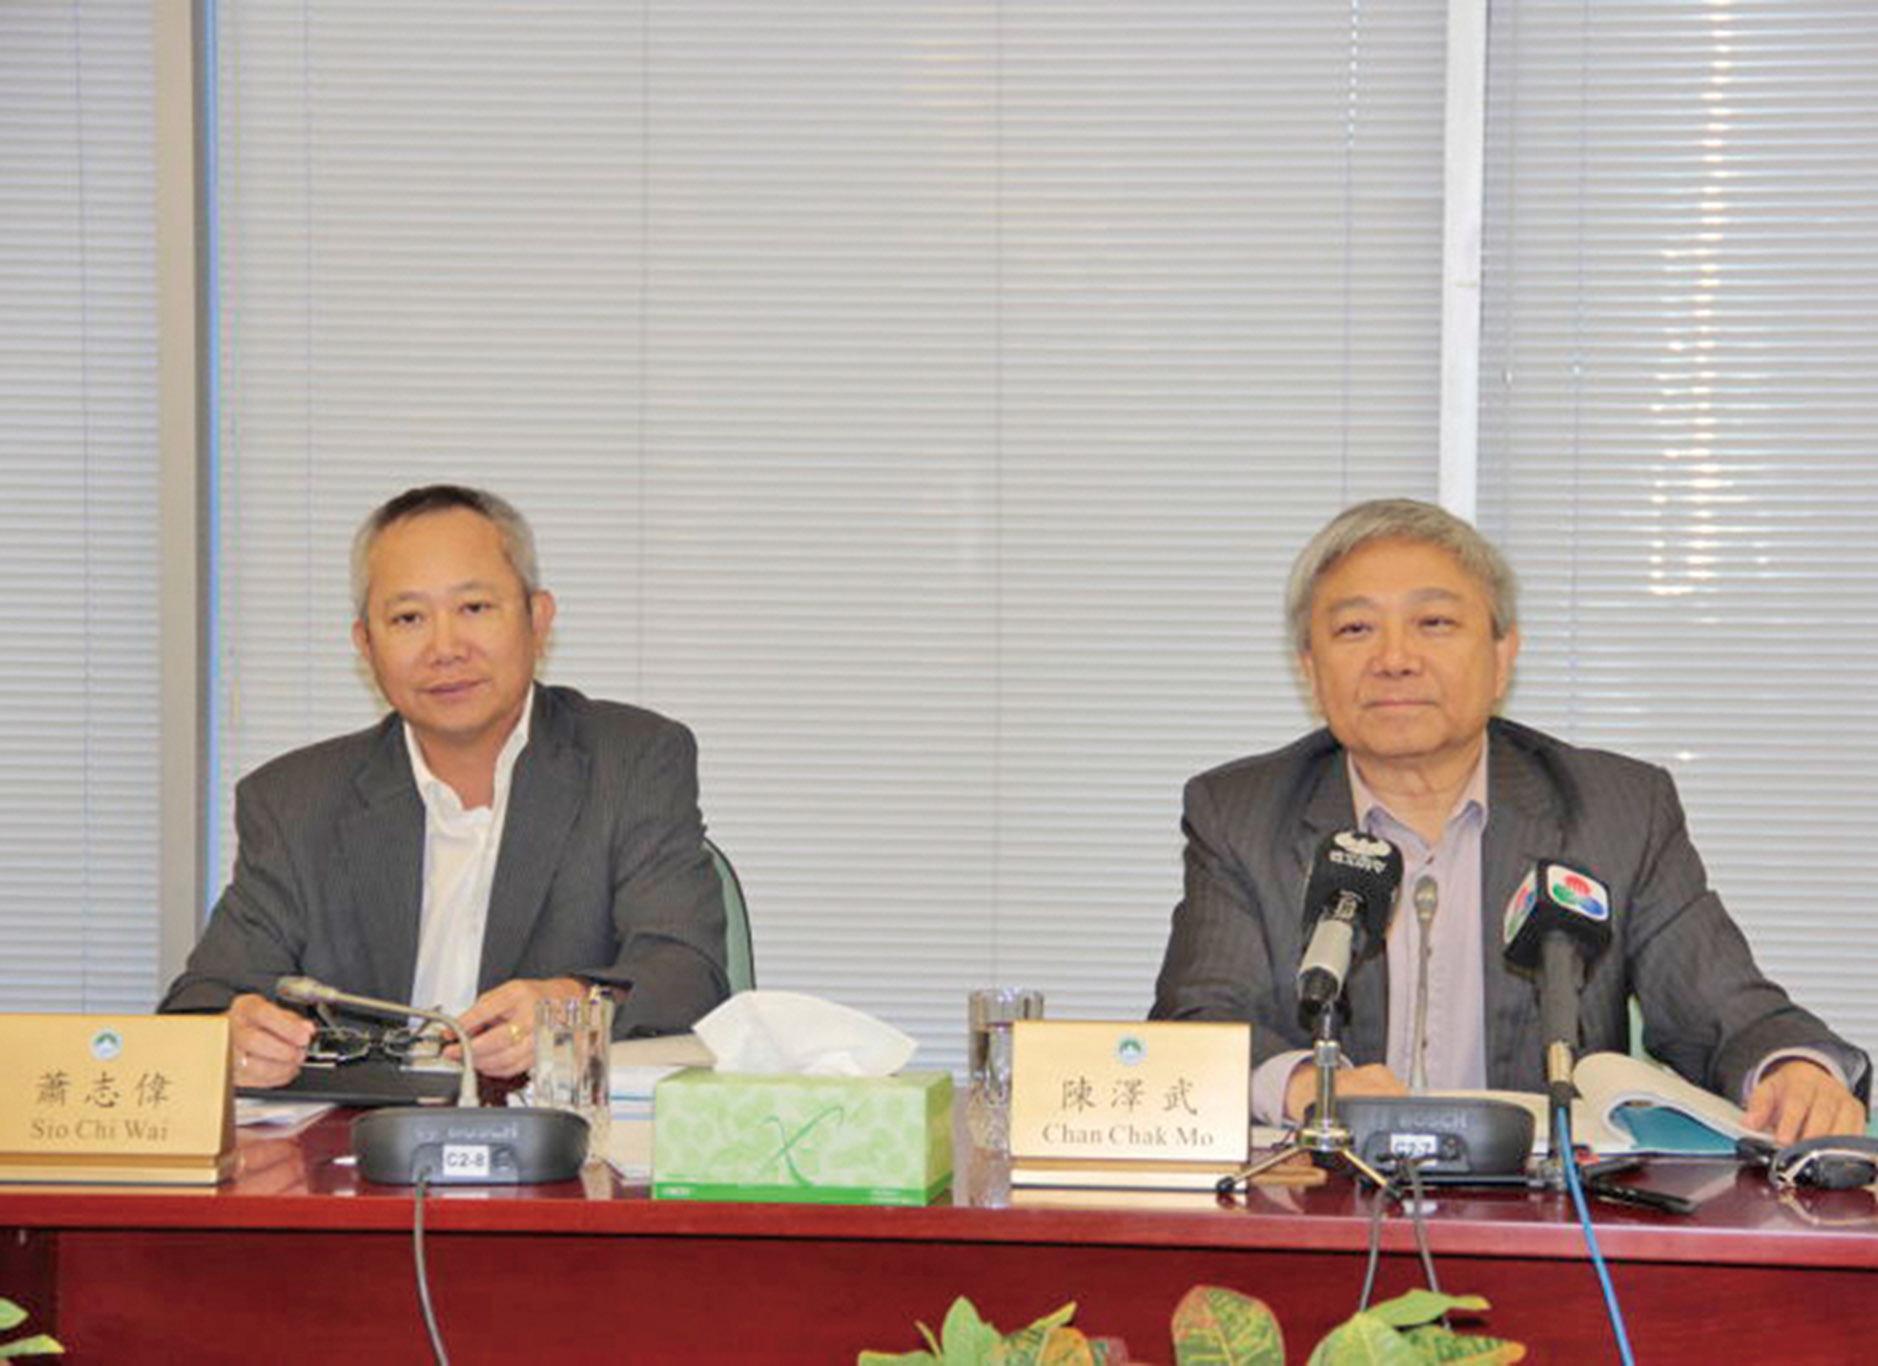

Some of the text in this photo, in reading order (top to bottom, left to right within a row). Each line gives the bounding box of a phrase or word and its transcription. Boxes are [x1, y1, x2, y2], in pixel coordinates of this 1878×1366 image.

[36, 1069, 174, 1109] 蕭志偉
[1061, 1075, 1198, 1116] 陳澤武
[30, 1118, 169, 1141] Sio Chi Wai
[1041, 1123, 1214, 1147] Chan Chak Mo
[446, 1152, 487, 1167] C2-8
